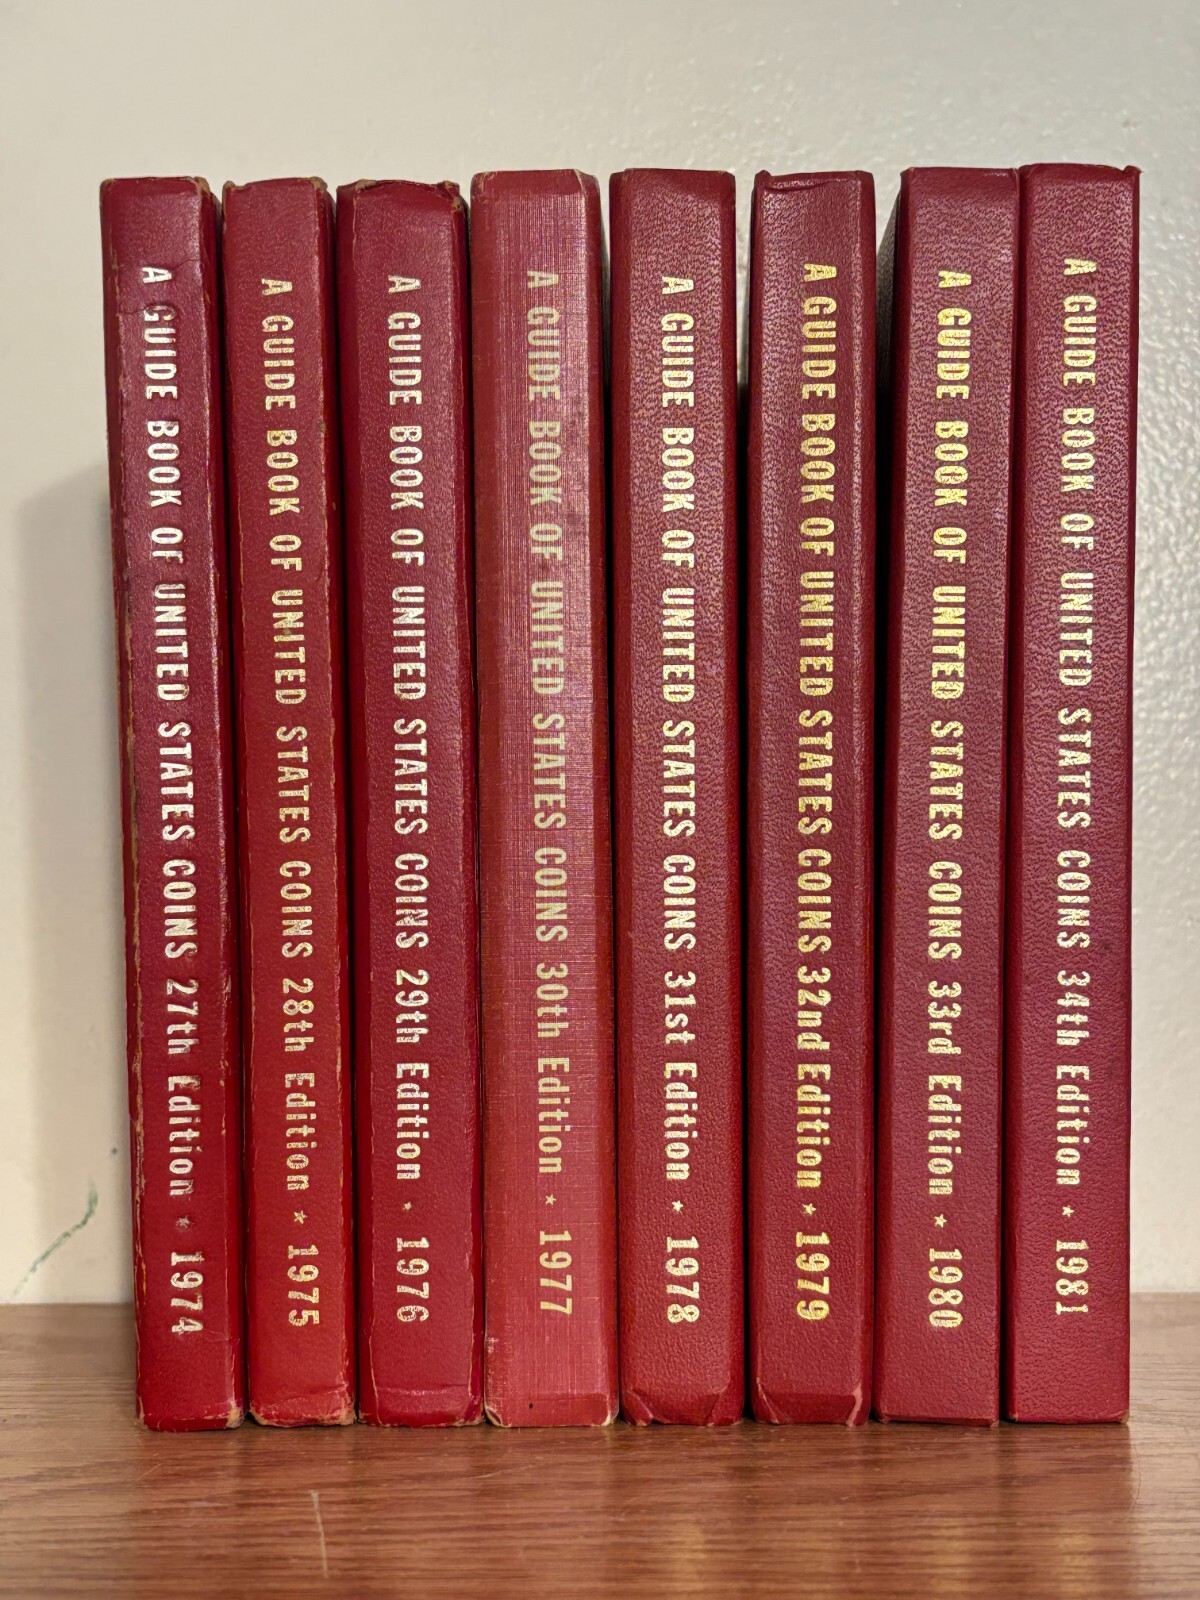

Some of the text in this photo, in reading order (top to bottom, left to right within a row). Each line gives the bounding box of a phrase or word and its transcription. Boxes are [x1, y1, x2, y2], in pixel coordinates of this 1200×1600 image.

[141, 265, 203, 1336] A GUIDE BOOK OF UNITED STATES COINS 27th Edition 1974
[261, 277, 320, 1326] A GUIDE BOOK OF UNITED STATES COINS 28th Edition 1975
[388, 274, 430, 1322] A GUIDE BOOK OF UNITED STATES COINS 29th Edition 1976
[527, 270, 573, 1315] A GUIDE BOOK OF UNITED STATES COINS 30th Edition 1977
[661, 275, 700, 1324] A GUIDE BOOK OF UNITED STATES COINS 31st Edition 1978
[795, 262, 837, 1321] A GUIDE BOOK OF UNITED STATES COINS 32nd Edition 1979
[927, 269, 972, 1328] A GUIDE BOOK OF UNITED STATES COINS 33rd Edition 1980
[1055, 257, 1097, 1315] A GUIDE BOOK OF UNITED STATES COINS 34th Edition 1981
